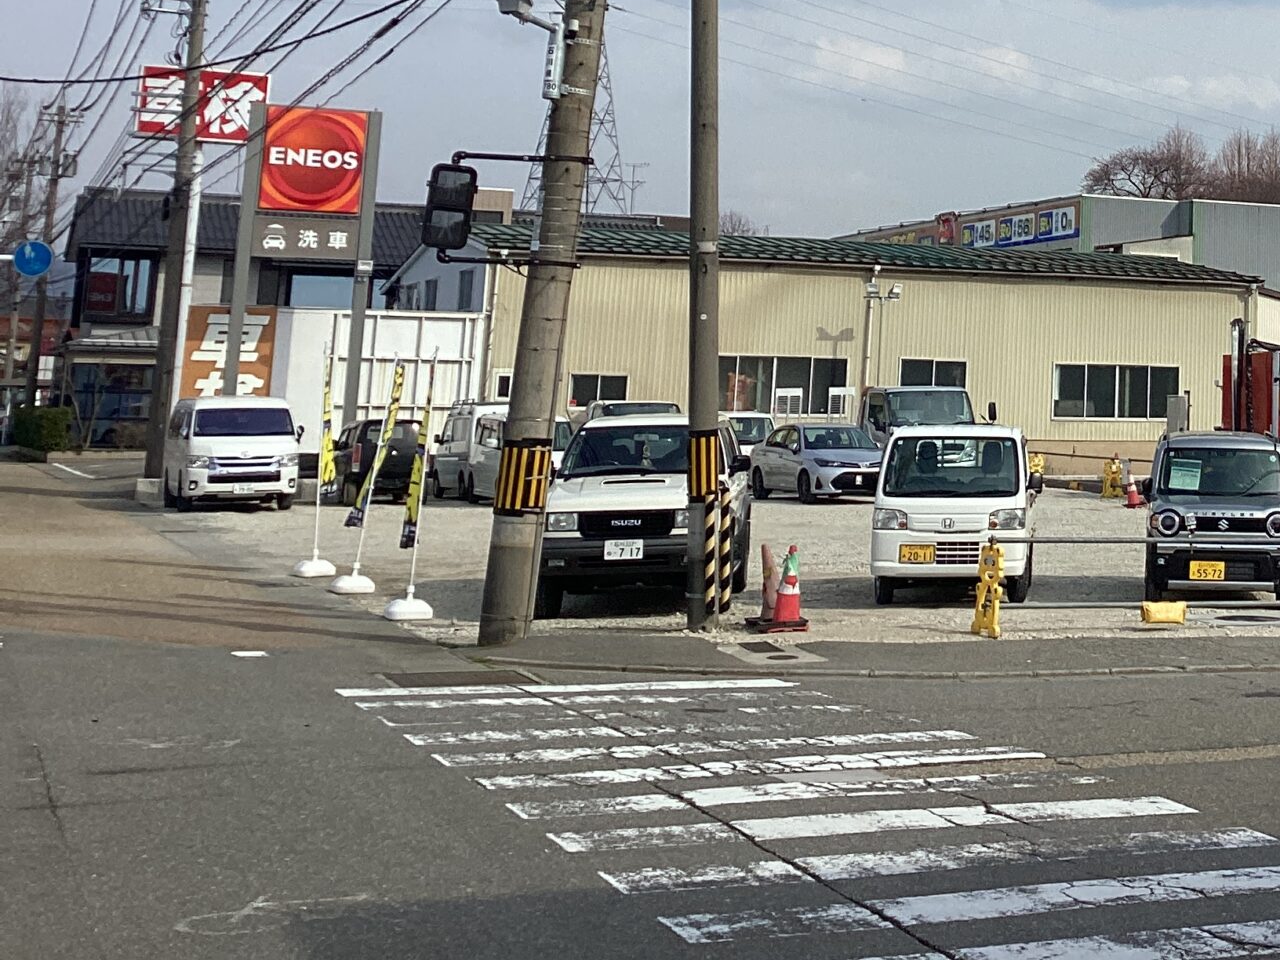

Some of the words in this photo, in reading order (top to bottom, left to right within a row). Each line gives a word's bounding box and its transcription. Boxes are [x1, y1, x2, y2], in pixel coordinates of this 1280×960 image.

[139, 75, 265, 135] 車検
[268, 146, 359, 170] ENEOS
[297, 229, 348, 249] 洗車
